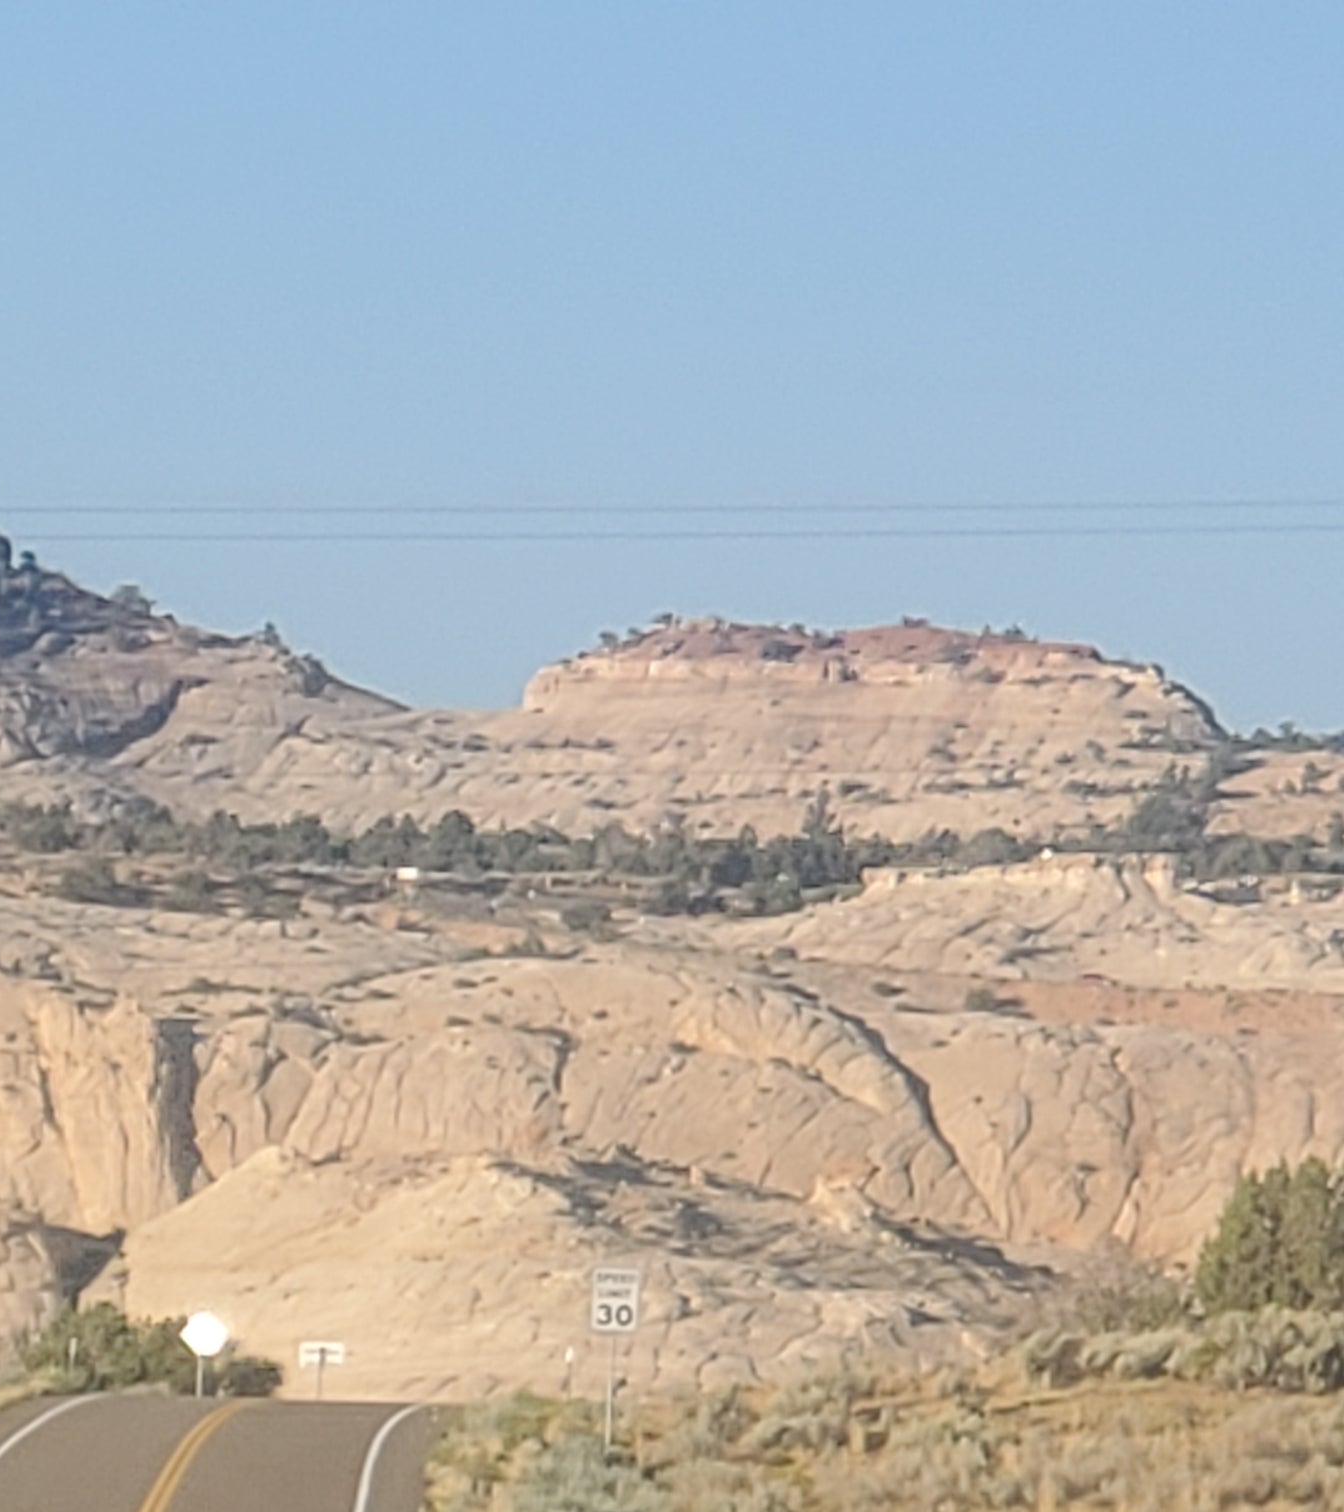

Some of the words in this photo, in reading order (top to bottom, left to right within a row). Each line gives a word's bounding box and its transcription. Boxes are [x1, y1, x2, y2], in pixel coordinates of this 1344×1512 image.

[597, 1272, 636, 1283] SPEED
[598, 1288, 631, 1298] LIMIT
[596, 1304, 633, 1326] 30
